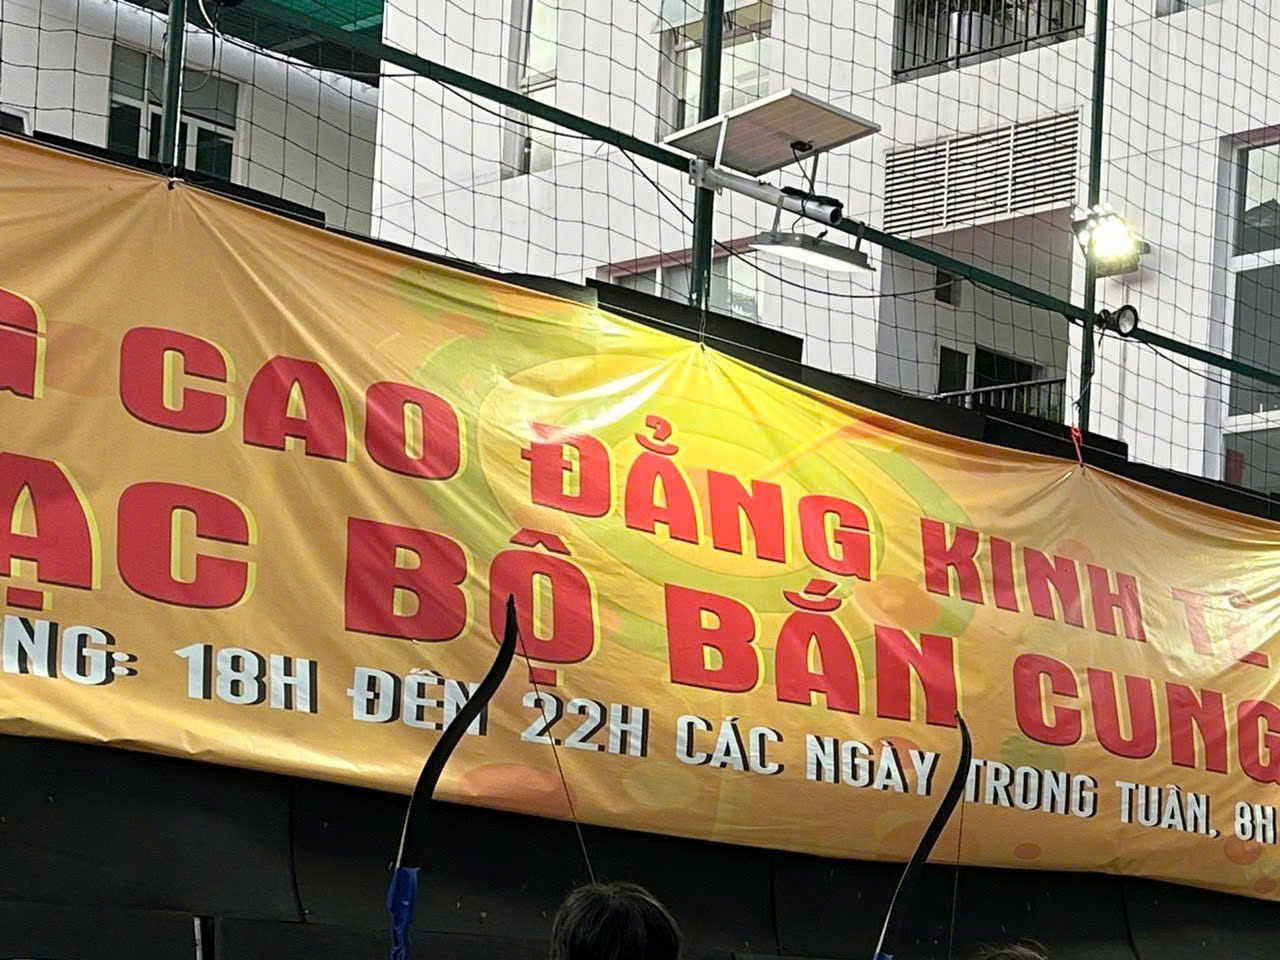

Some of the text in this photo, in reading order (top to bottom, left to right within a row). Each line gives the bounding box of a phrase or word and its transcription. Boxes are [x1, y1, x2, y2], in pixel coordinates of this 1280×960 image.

[118, 326, 463, 481] CAO
[521, 414, 875, 581] ĐẲNG
[919, 516, 1148, 642] KINH
[344, 515, 596, 686] BỘ
[664, 578, 959, 728] BẮN
[174, 642, 317, 714] 18H
[520, 691, 650, 758] 22H
[676, 714, 784, 776] CÁC
[806, 734, 941, 797] NGÀY
[966, 758, 1099, 818] TRONG
[1234, 801, 1278, 845] 8H
